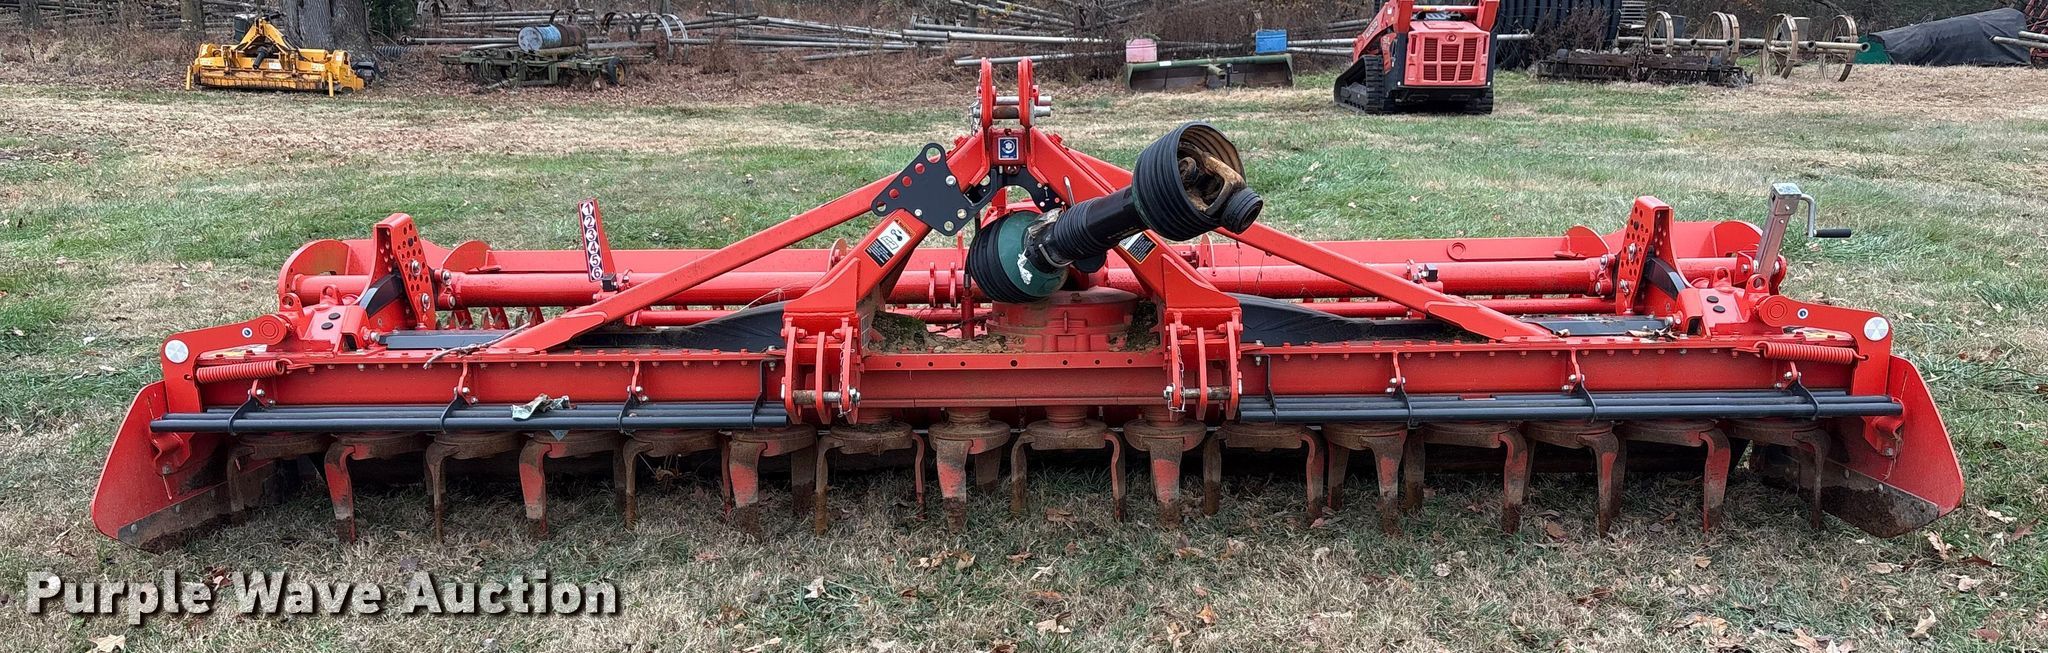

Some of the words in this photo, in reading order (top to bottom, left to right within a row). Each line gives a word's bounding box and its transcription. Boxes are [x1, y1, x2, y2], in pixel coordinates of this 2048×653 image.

[585, 203, 591, 214] 1
[586, 216, 593, 227] 2
[588, 229, 595, 240] 3
[590, 242, 597, 253] 4
[592, 255, 599, 266] 5
[593, 267, 601, 278] 6
